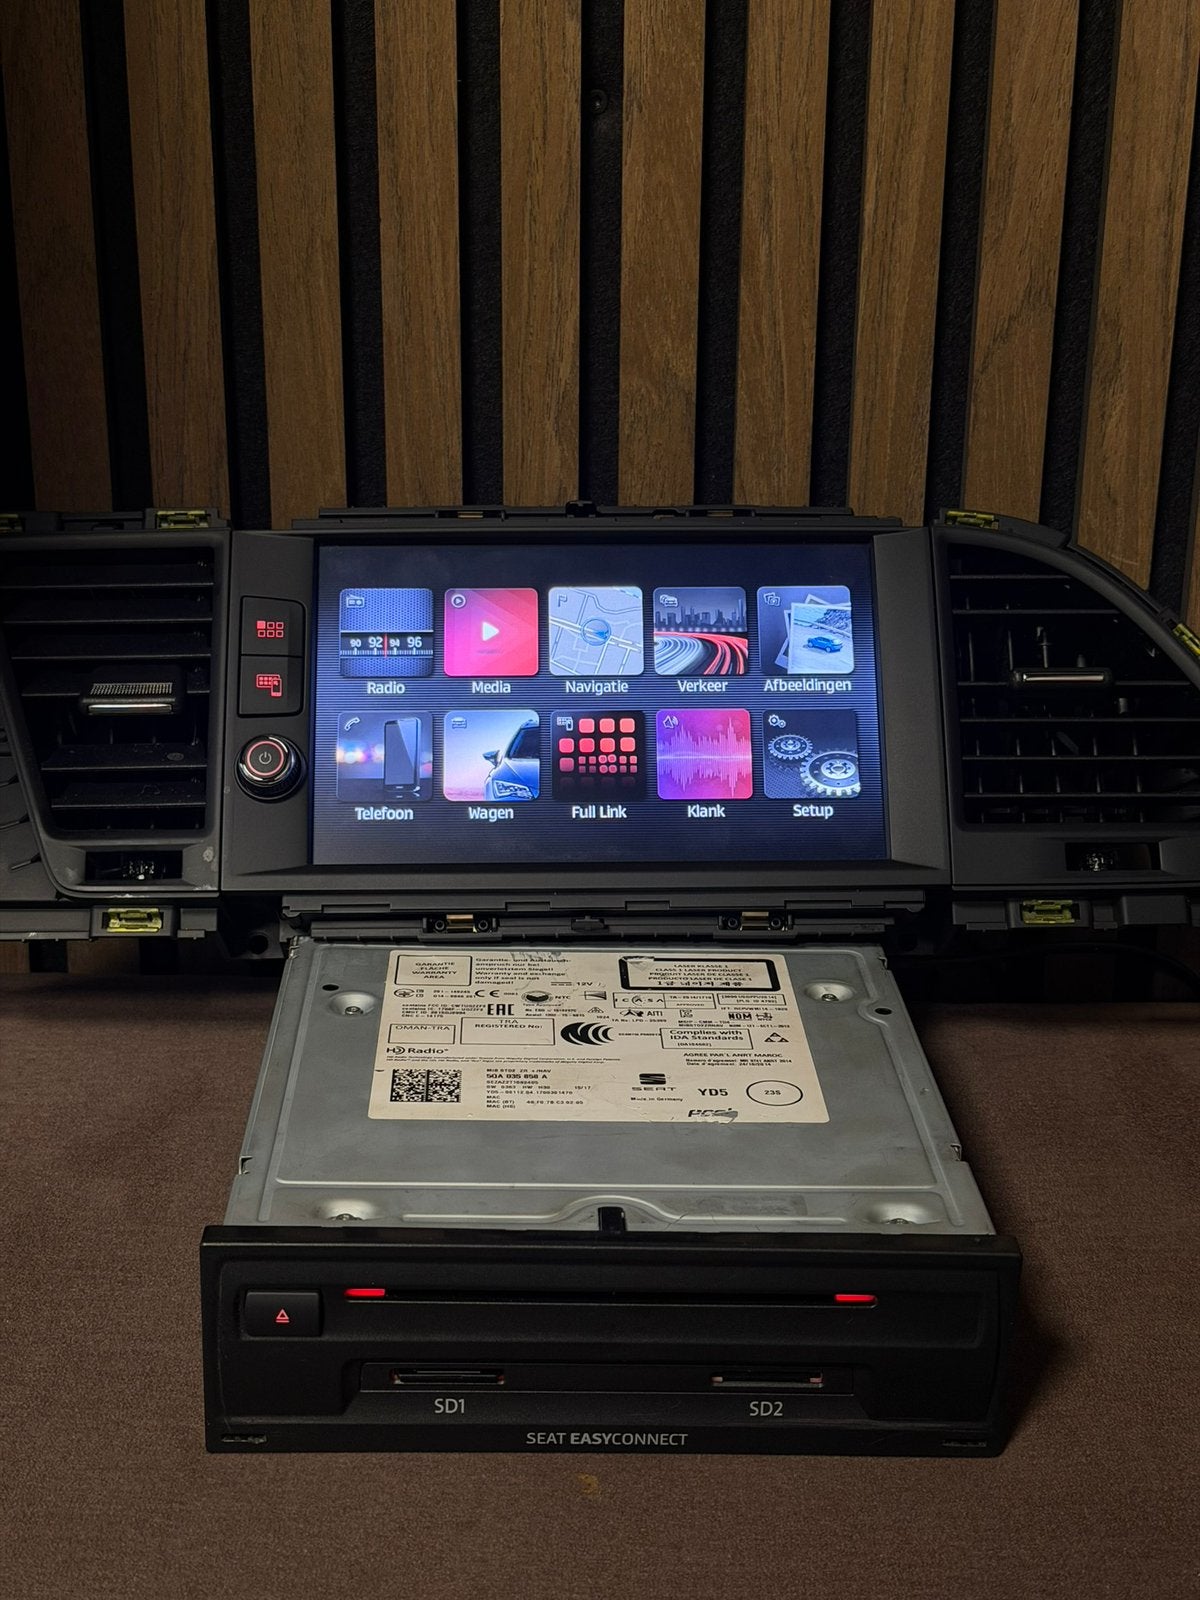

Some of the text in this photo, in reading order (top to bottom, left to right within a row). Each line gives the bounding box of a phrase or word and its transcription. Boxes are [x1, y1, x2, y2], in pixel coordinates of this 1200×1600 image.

[350, 636, 422, 648] 90 92 94 96
[367, 681, 405, 694] Radio
[472, 680, 511, 694] Media
[565, 679, 629, 696] Navigatie
[677, 679, 728, 692] Verkeer
[764, 678, 851, 694] Afbeeldingen
[355, 806, 414, 820] Telefoon
[468, 806, 514, 822] Wagen
[571, 805, 627, 818] Full Link
[687, 804, 726, 818] Klank
[793, 804, 834, 819] Setup
[487, 1004, 515, 1016] EAC
[728, 1012, 752, 1020] NOM
[698, 1088, 728, 1096] YD5
[434, 1398, 465, 1414] SD1
[749, 1401, 783, 1416] SD2
[526, 1432, 688, 1446] SEAT EASYCONNECT
